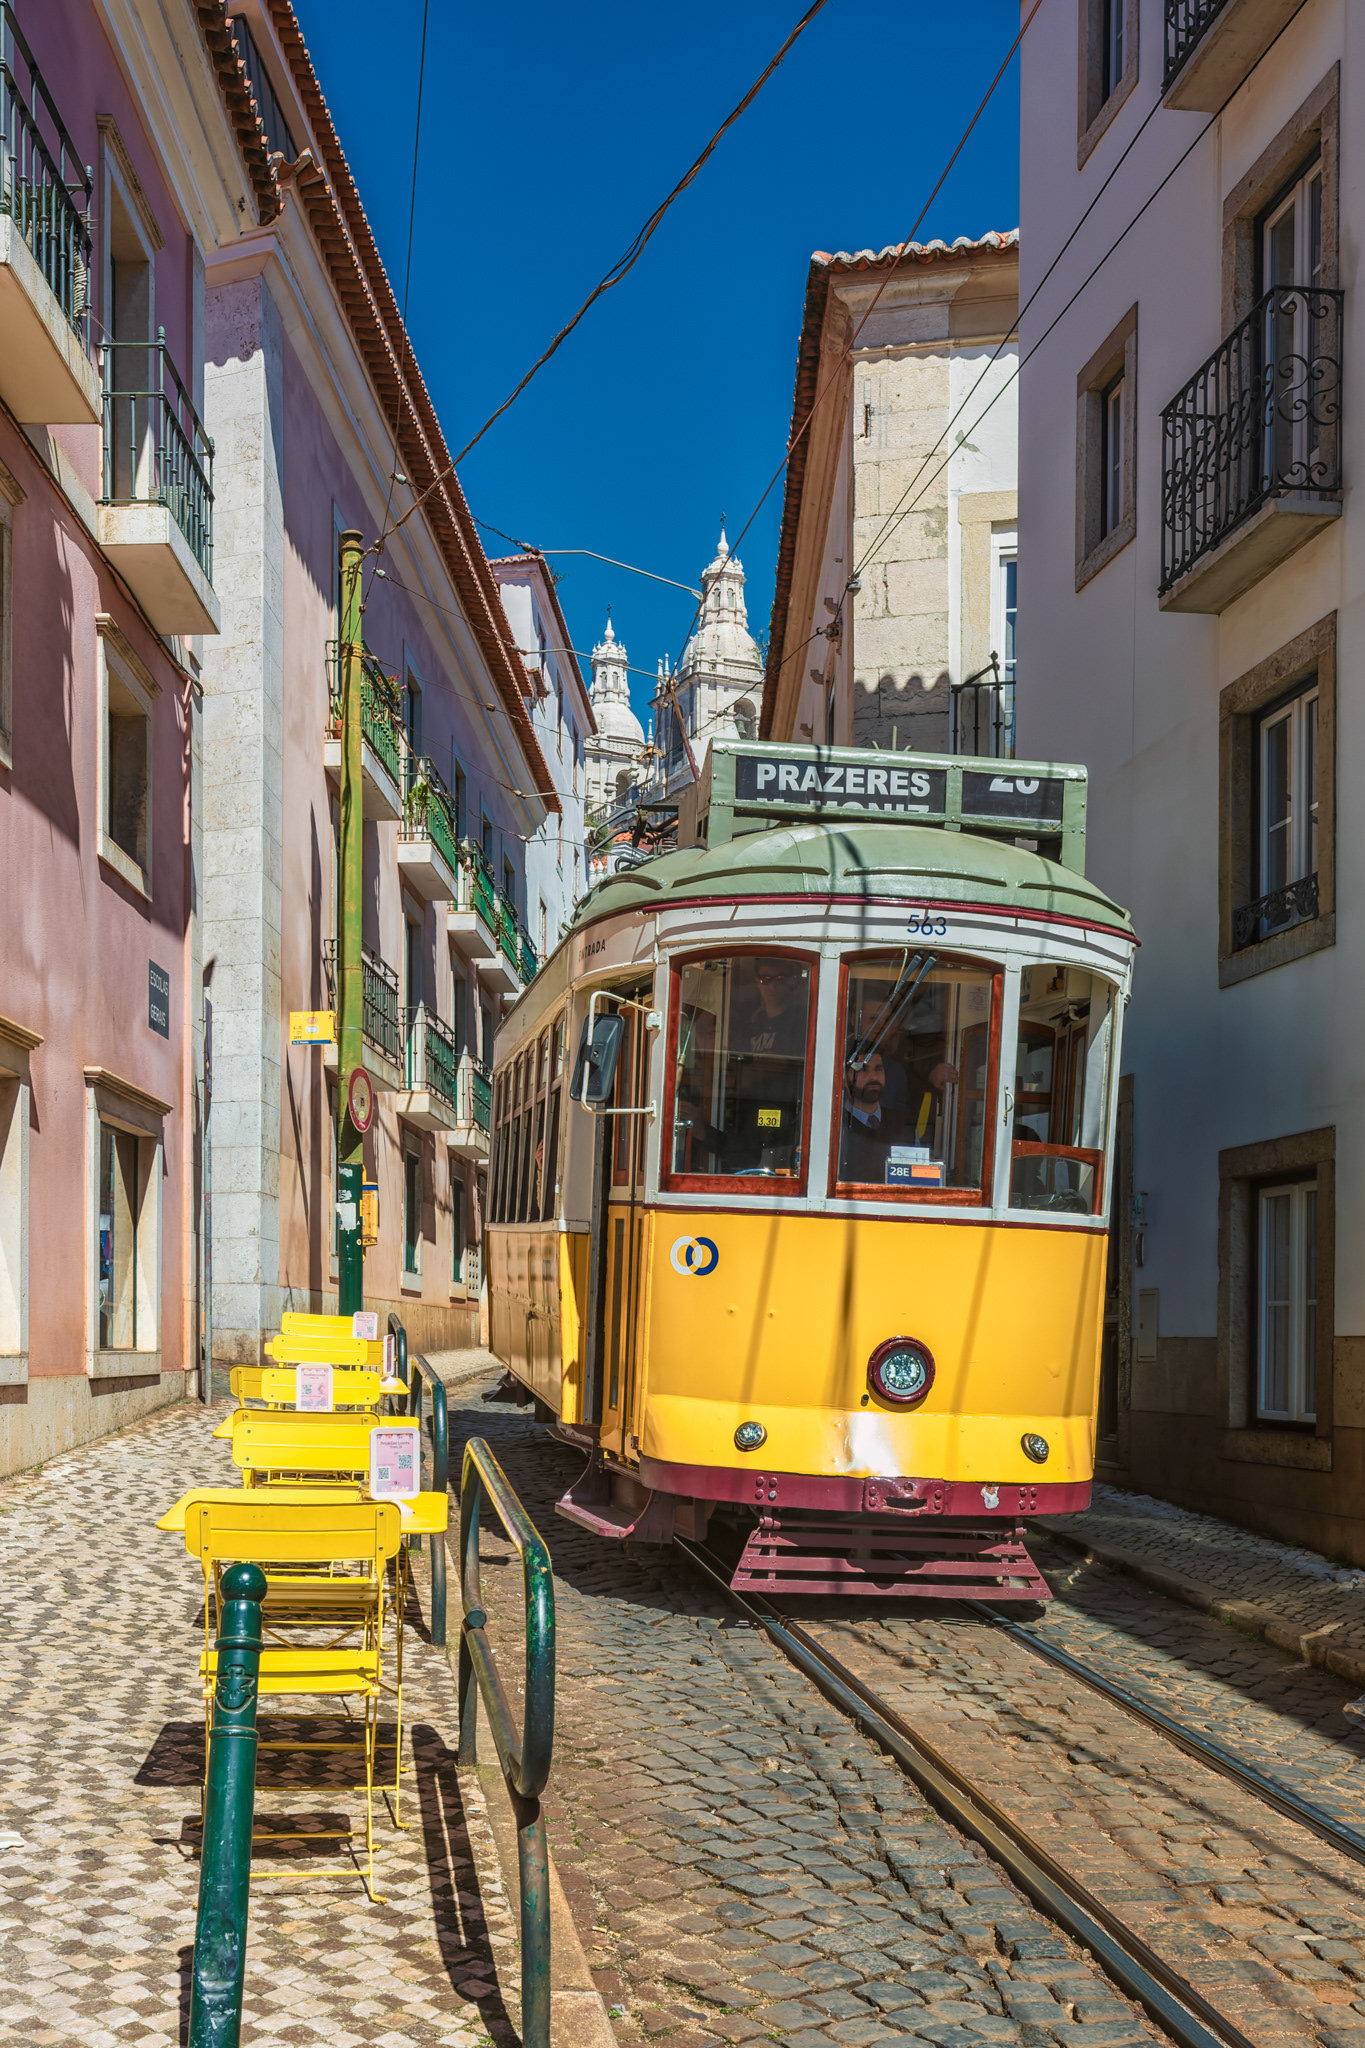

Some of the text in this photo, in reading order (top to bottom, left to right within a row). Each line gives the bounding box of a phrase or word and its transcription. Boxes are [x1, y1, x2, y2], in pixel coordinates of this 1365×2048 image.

[756, 763, 931, 797] PRAZERES
[906, 914, 947, 935] 563
[150, 970, 168, 996] ESCOLAS
[150, 1003, 166, 1027] GERAIS
[889, 1166, 910, 1177] 28E
